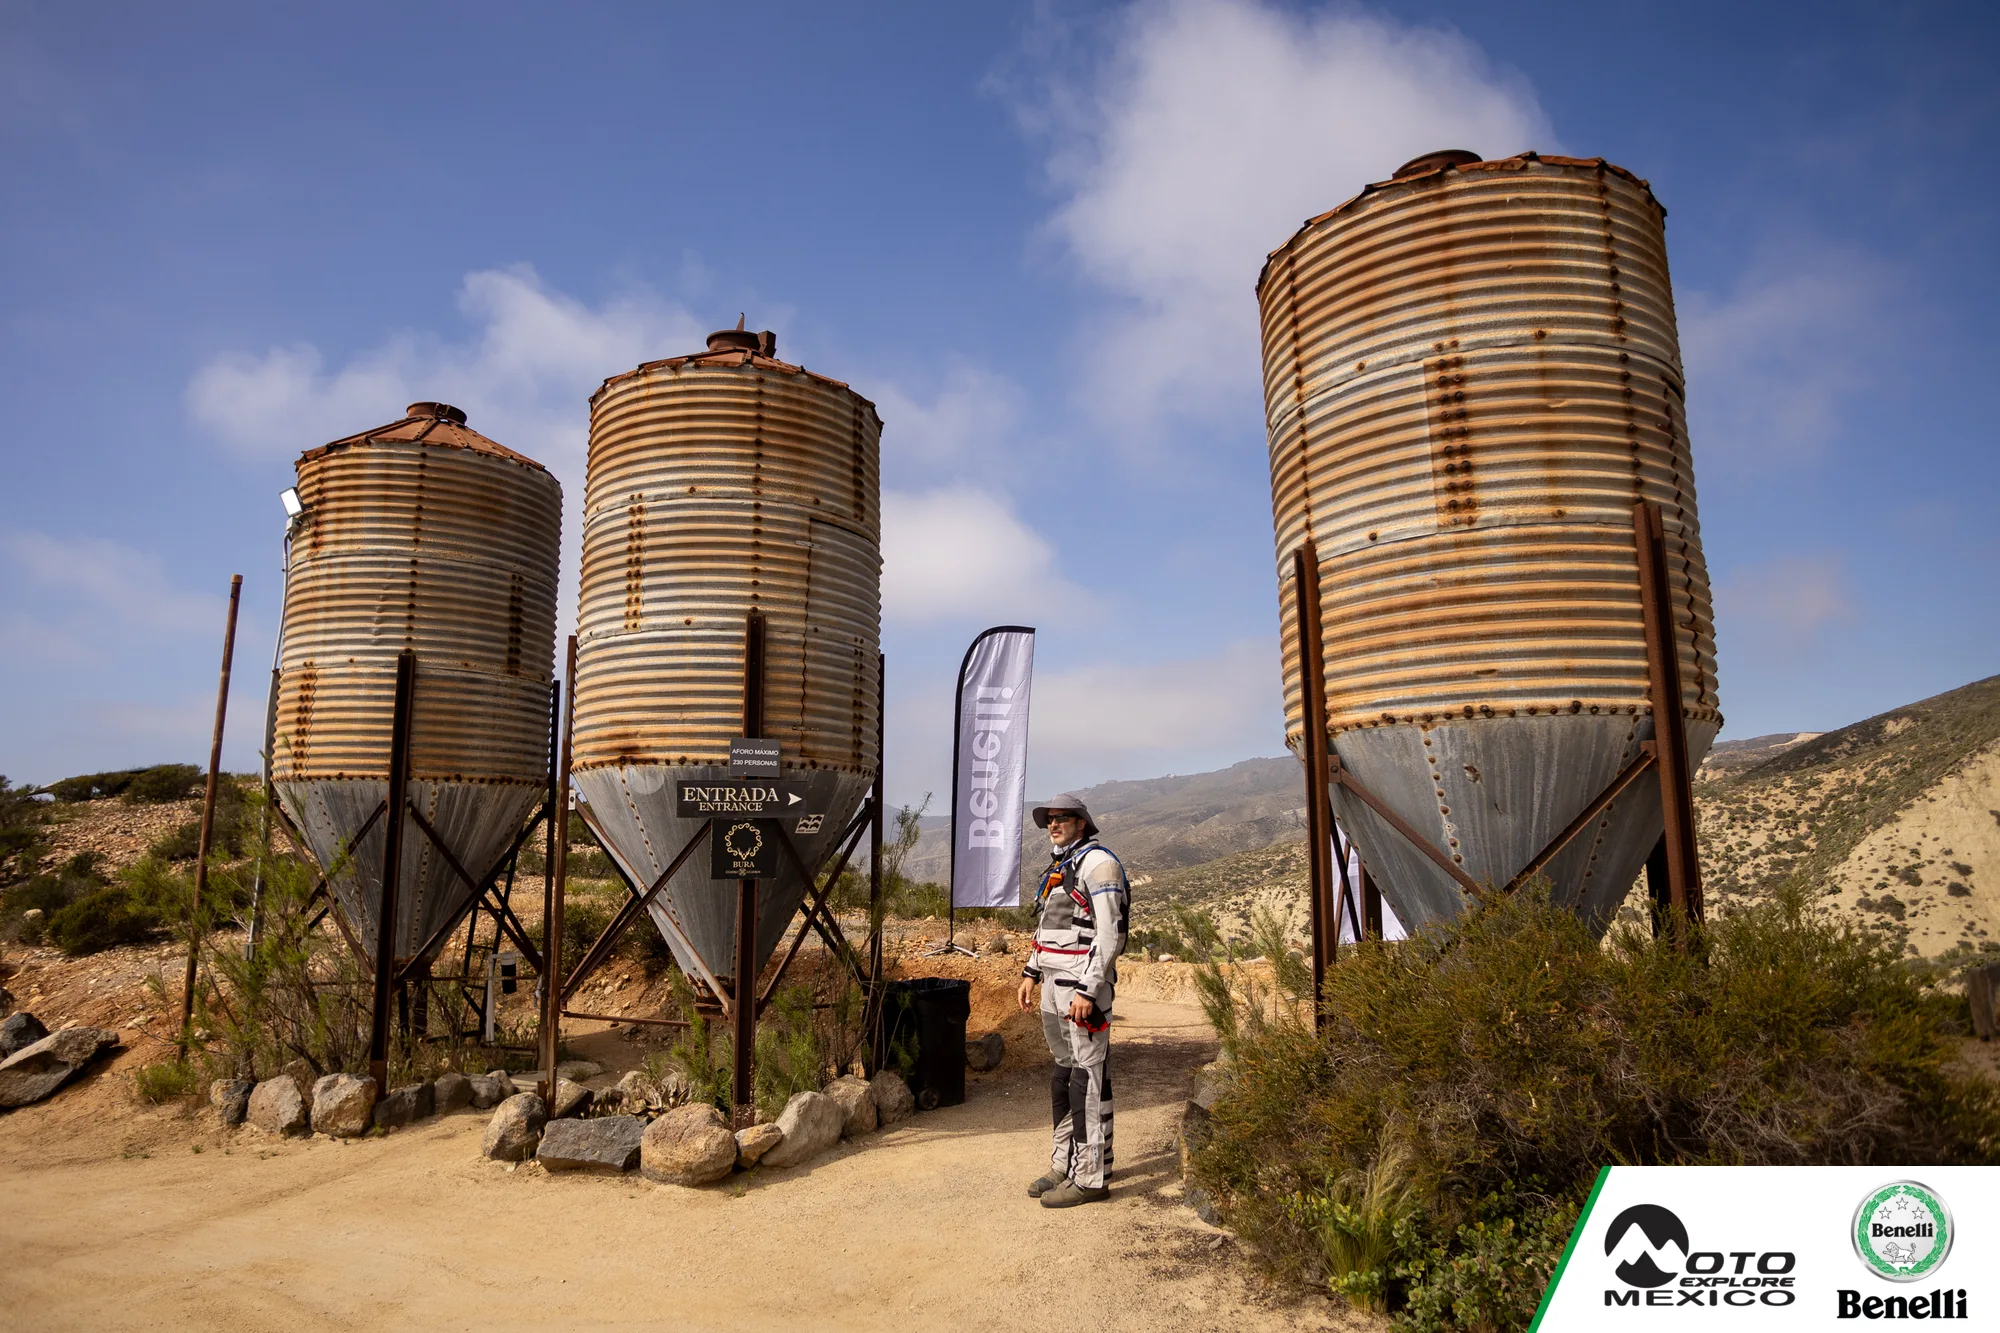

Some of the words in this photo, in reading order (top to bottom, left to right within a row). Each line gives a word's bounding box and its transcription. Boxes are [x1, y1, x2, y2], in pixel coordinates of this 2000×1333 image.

[754, 748, 779, 756] MÁXIMO
[744, 759, 778, 767] PERSONAS
[683, 787, 780, 802] ENTRADA
[699, 802, 763, 812] ENTRANCE
